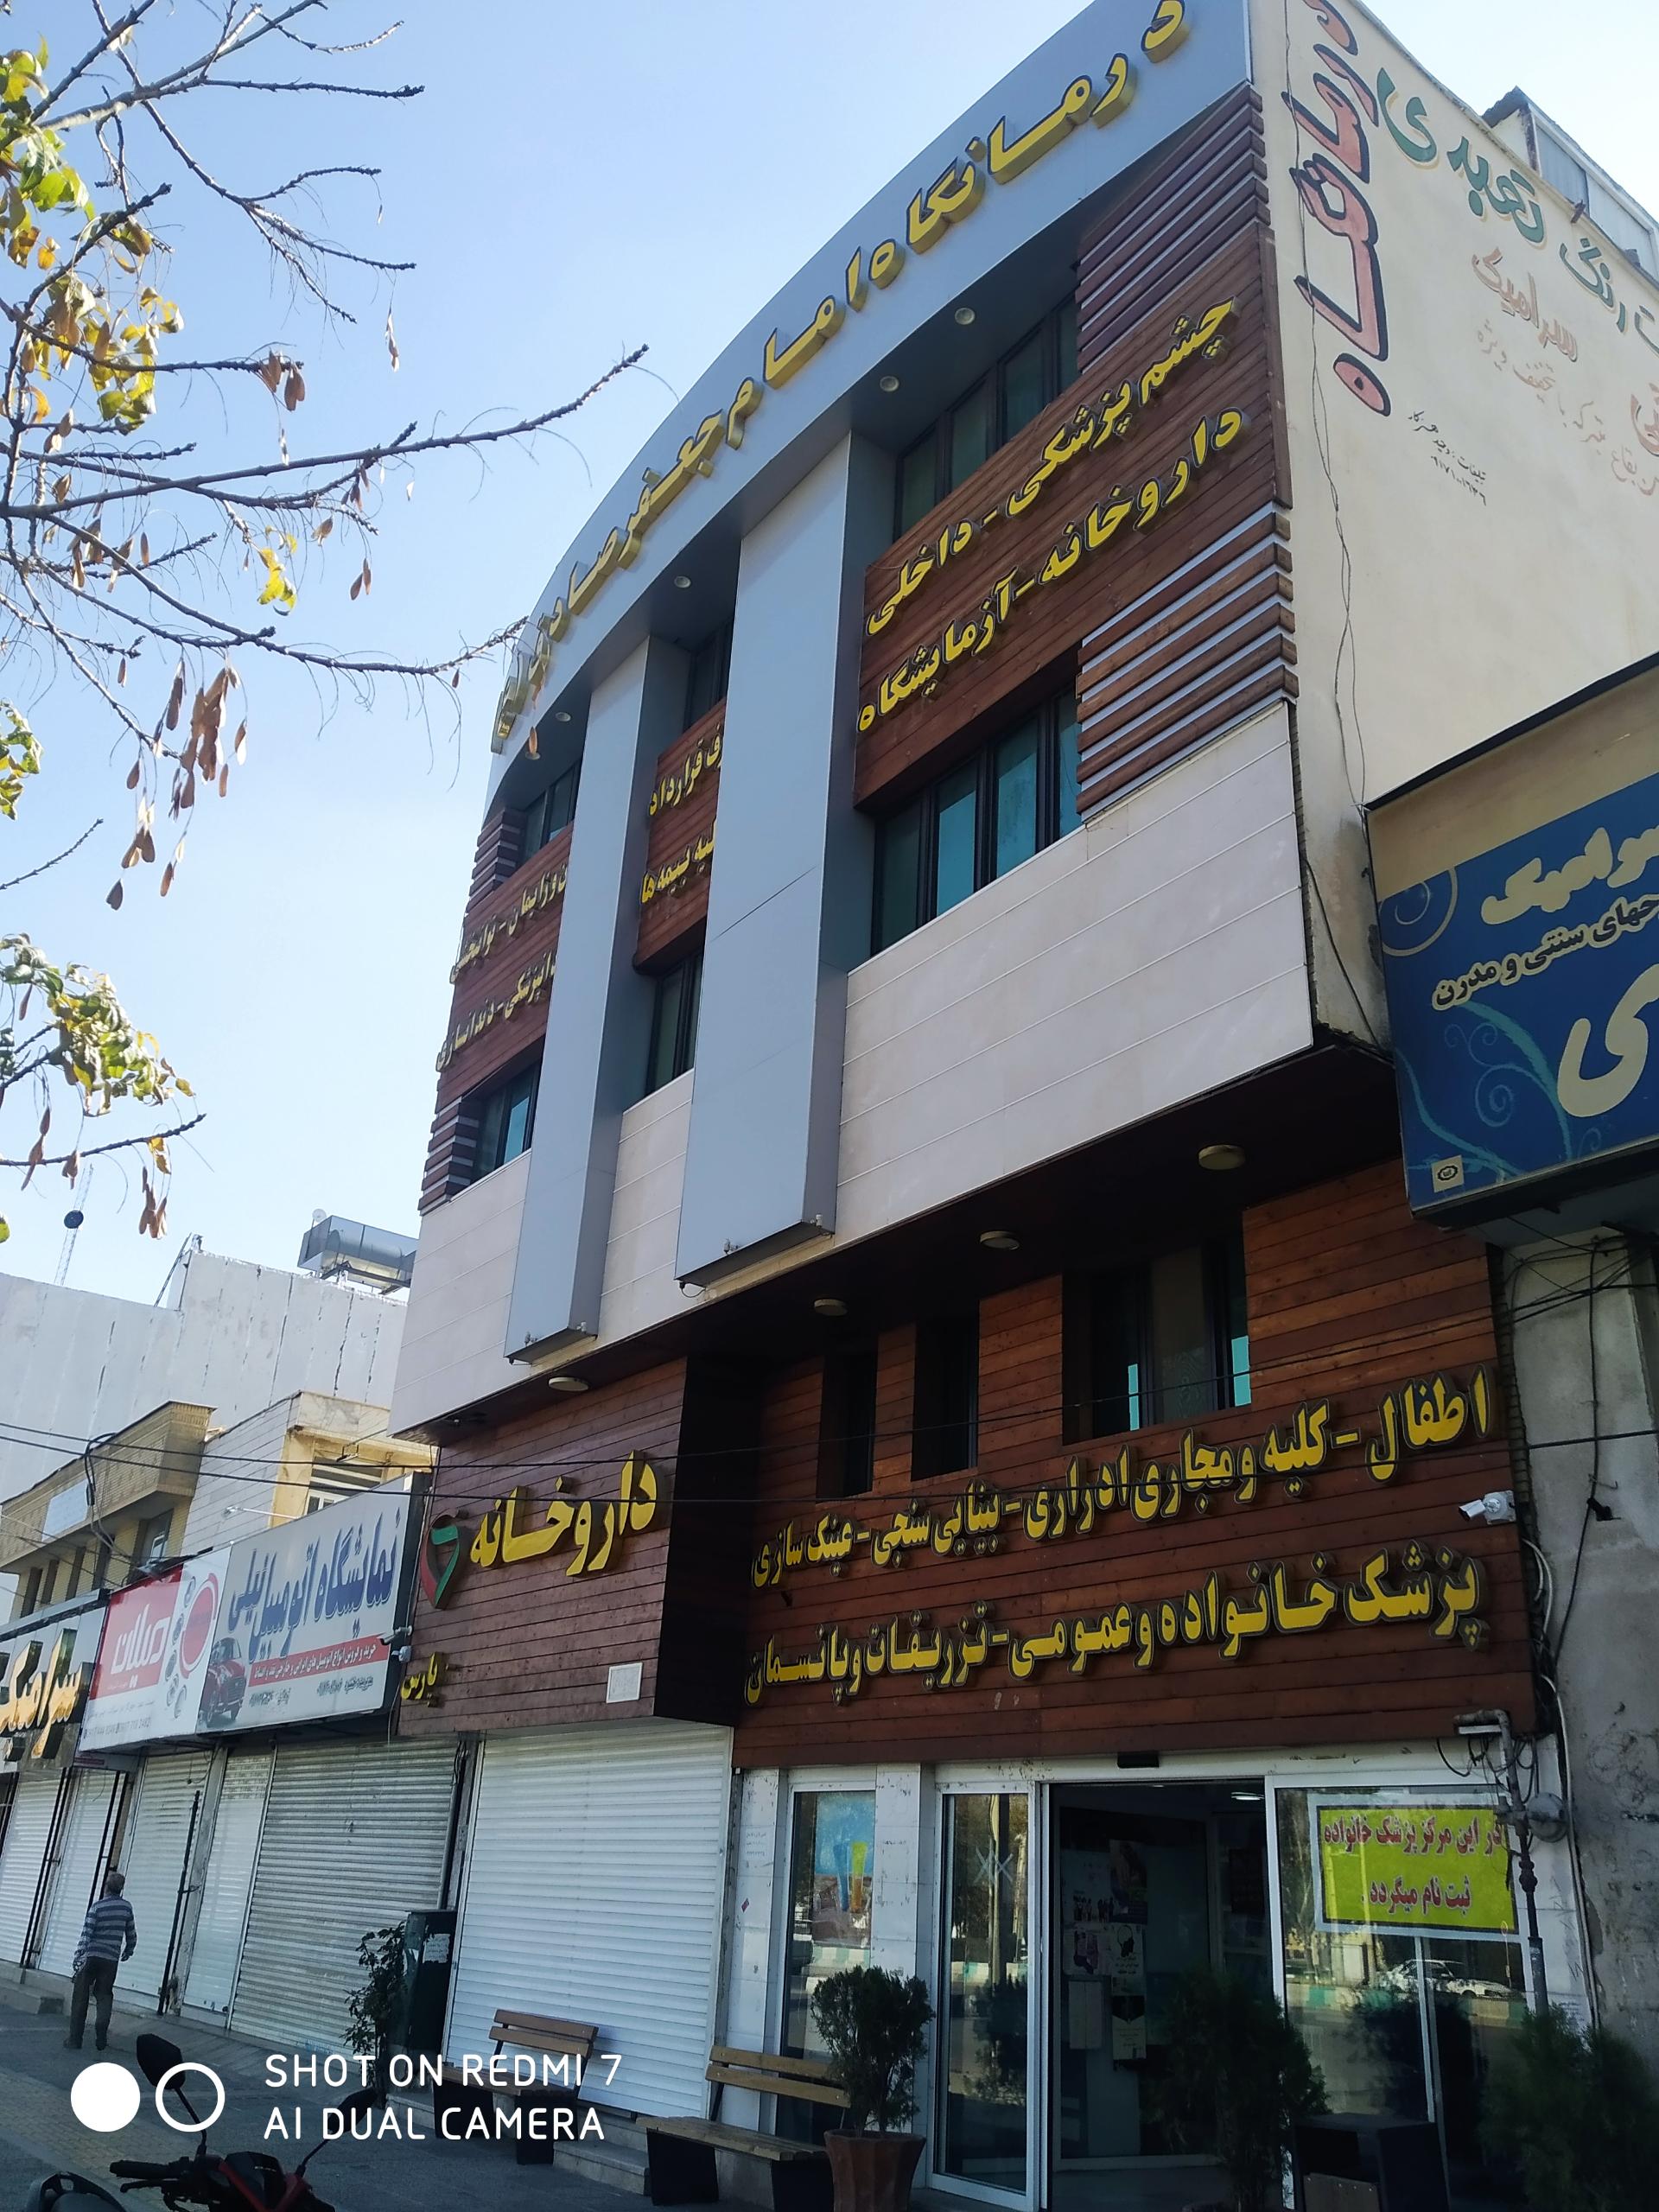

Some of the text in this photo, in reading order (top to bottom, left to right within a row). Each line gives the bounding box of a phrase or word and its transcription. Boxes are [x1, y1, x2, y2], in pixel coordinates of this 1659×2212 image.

[725, 246, 867, 449] امام
[617, 408, 724, 569] جعفر
[865, 296, 1239, 636] چشم پزشکی داخلی
[1039, 407, 1244, 586] داروخانه
[1435, 963, 1498, 1007] مدرن
[1504, 957, 1518, 982] و
[1525, 929, 1585, 971] سنتی
[1260, 1397, 1331, 1497] کلیه
[1366, 1363, 1491, 1483] اطفال
[470, 1450, 657, 1577] داروخانه
[1023, 1445, 1129, 1541] ادراری
[1130, 1428, 1235, 1521] مجاری
[1236, 1445, 1256, 1503] و
[315, 1507, 401, 1638] نمایشگاه
[752, 1521, 804, 1588] سازی
[805, 1513, 853, 1578] عینک
[872, 1498, 931, 1568] سنجی
[249, 1537, 321, 1664] اتومبیل
[1156, 1552, 1338, 1659] خانواده
[1344, 1540, 1486, 1650] پزشک
[864, 1600, 987, 1688] تزریقات
[1007, 1601, 1133, 1681] عمومی
[1135, 1610, 1154, 1669] و
[1324, 1815, 1373, 1853] خانواده
[1376, 1815, 1418, 1855] پزشک
[1421, 1815, 1452, 1855] مرکز
[1456, 1816, 1479, 1855] این
[1422, 1875, 1442, 1915] نام
[1446, 1875, 1471, 1916] ثبت
